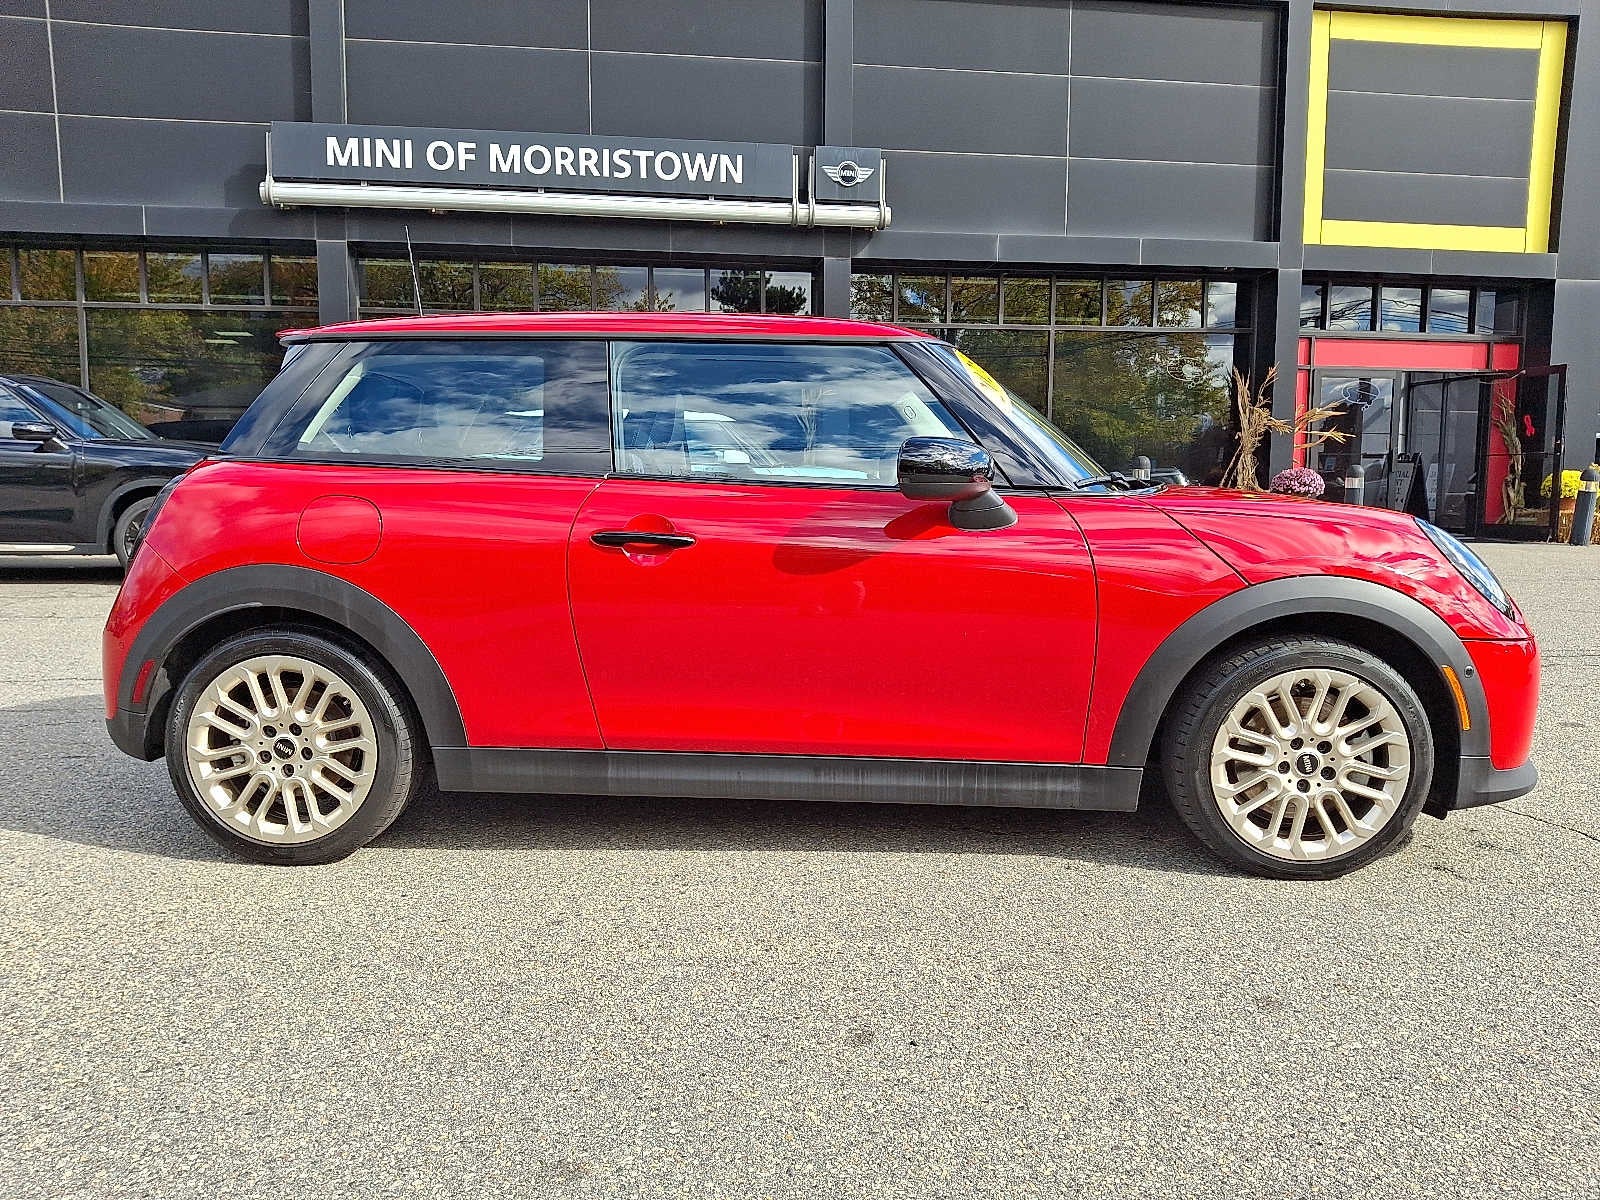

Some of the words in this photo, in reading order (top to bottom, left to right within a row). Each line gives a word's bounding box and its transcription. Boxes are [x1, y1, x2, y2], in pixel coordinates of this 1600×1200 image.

[326, 136, 413, 169] MINI
[426, 140, 477, 171] OF
[489, 143, 743, 184] MORRISTOWN
[840, 169, 858, 177] MINI
[276, 742, 294, 755] MINI
[1302, 754, 1313, 773] MINI
